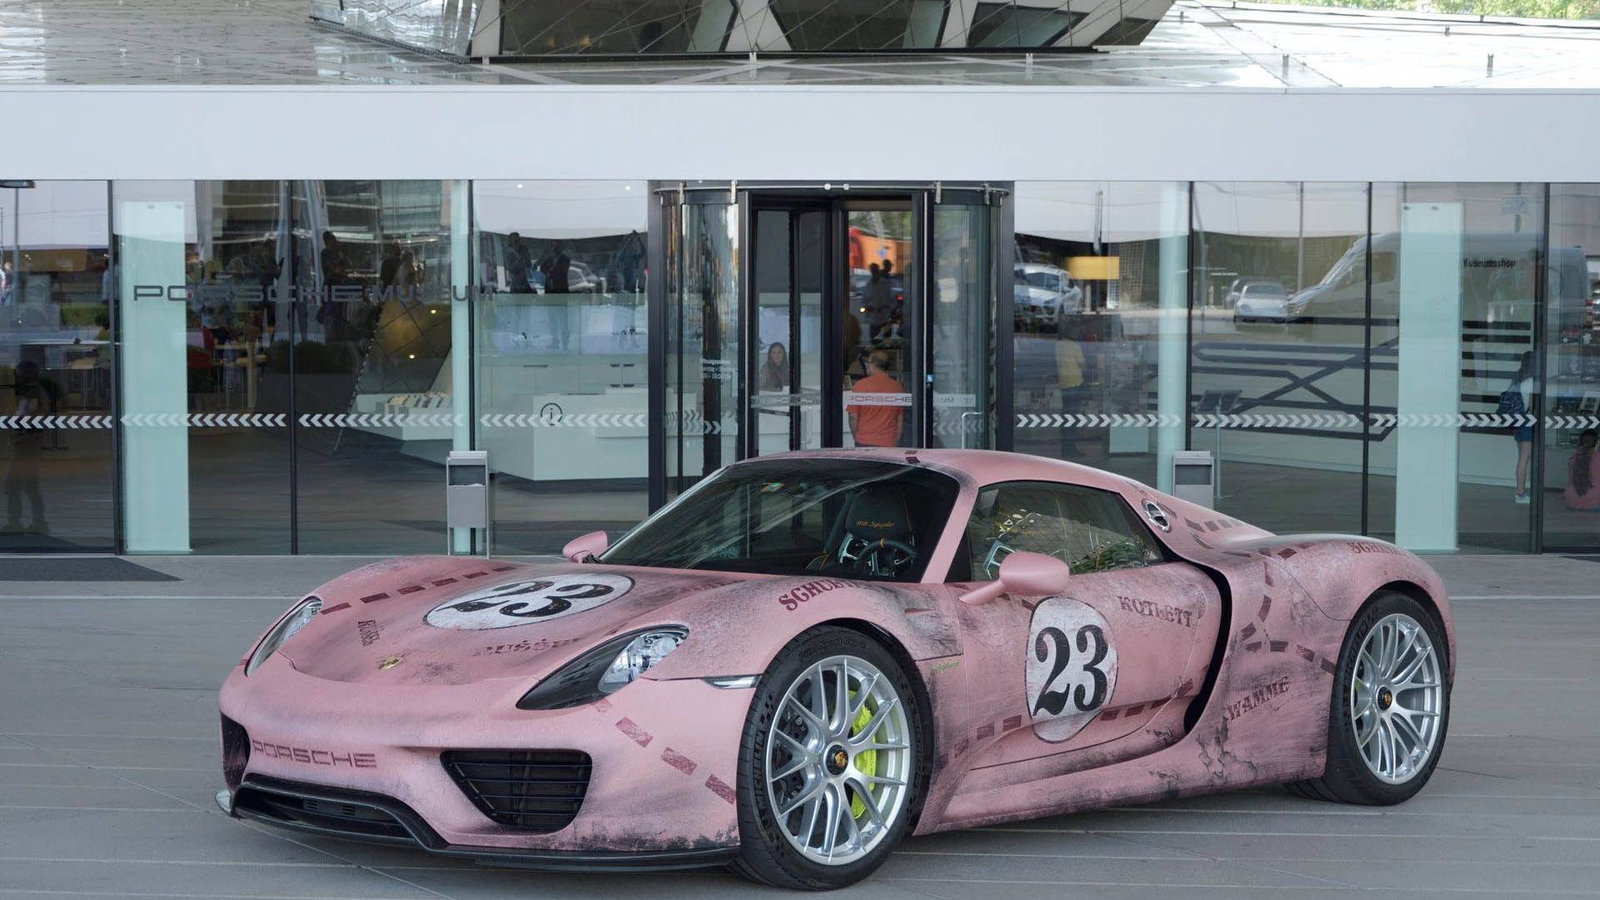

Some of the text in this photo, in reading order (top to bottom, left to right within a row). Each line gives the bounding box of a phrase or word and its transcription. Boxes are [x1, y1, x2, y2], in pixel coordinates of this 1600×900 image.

[134, 285, 363, 301] PORSCHE
[434, 580, 615, 618] 23
[1032, 624, 1109, 717] 23
[1227, 675, 1290, 721] WAMME
[252, 739, 378, 769] PORSCHE
